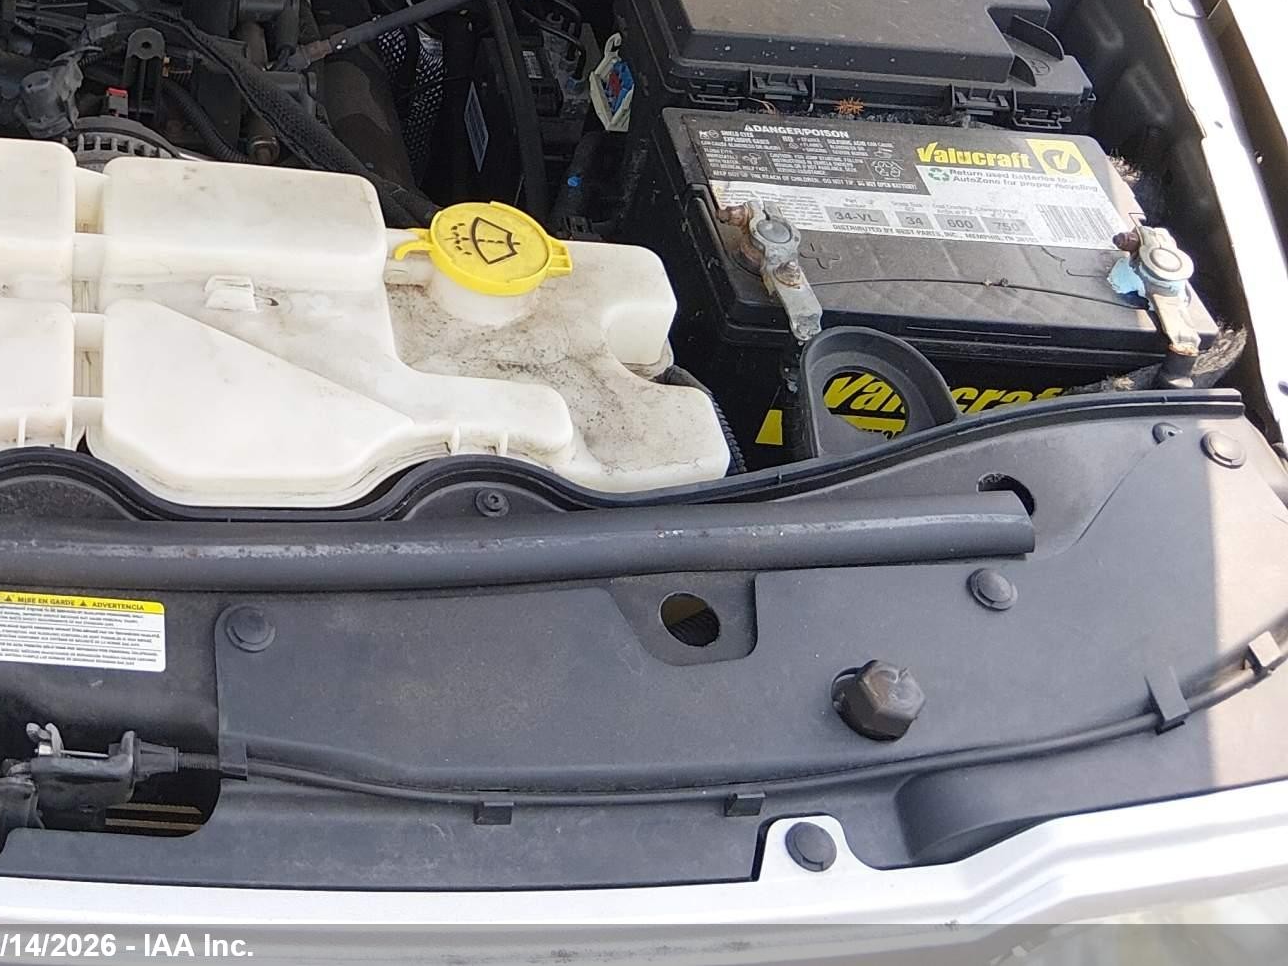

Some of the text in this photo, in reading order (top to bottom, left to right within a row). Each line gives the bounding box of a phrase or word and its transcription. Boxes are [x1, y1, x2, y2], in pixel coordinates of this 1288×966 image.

[753, 125, 850, 138] DANGER/POISON
[916, 142, 1032, 169] Valucraft
[950, 169, 983, 178] Return
[986, 171, 1009, 180] used
[953, 175, 1000, 185] AutoZone
[1003, 178, 1016, 186] for
[1019, 180, 1051, 189] proper
[835, 211, 878, 222] 34-VL
[905, 216, 923, 226] 34
[833, 224, 883, 233] DISTRIBUTED
[947, 219, 973, 229] 600
[993, 221, 1020, 232] 750
[17, 596, 36, 604] MISE
[50, 598, 75, 606] GARDE
[92, 601, 145, 611] ADVERTENCIA
